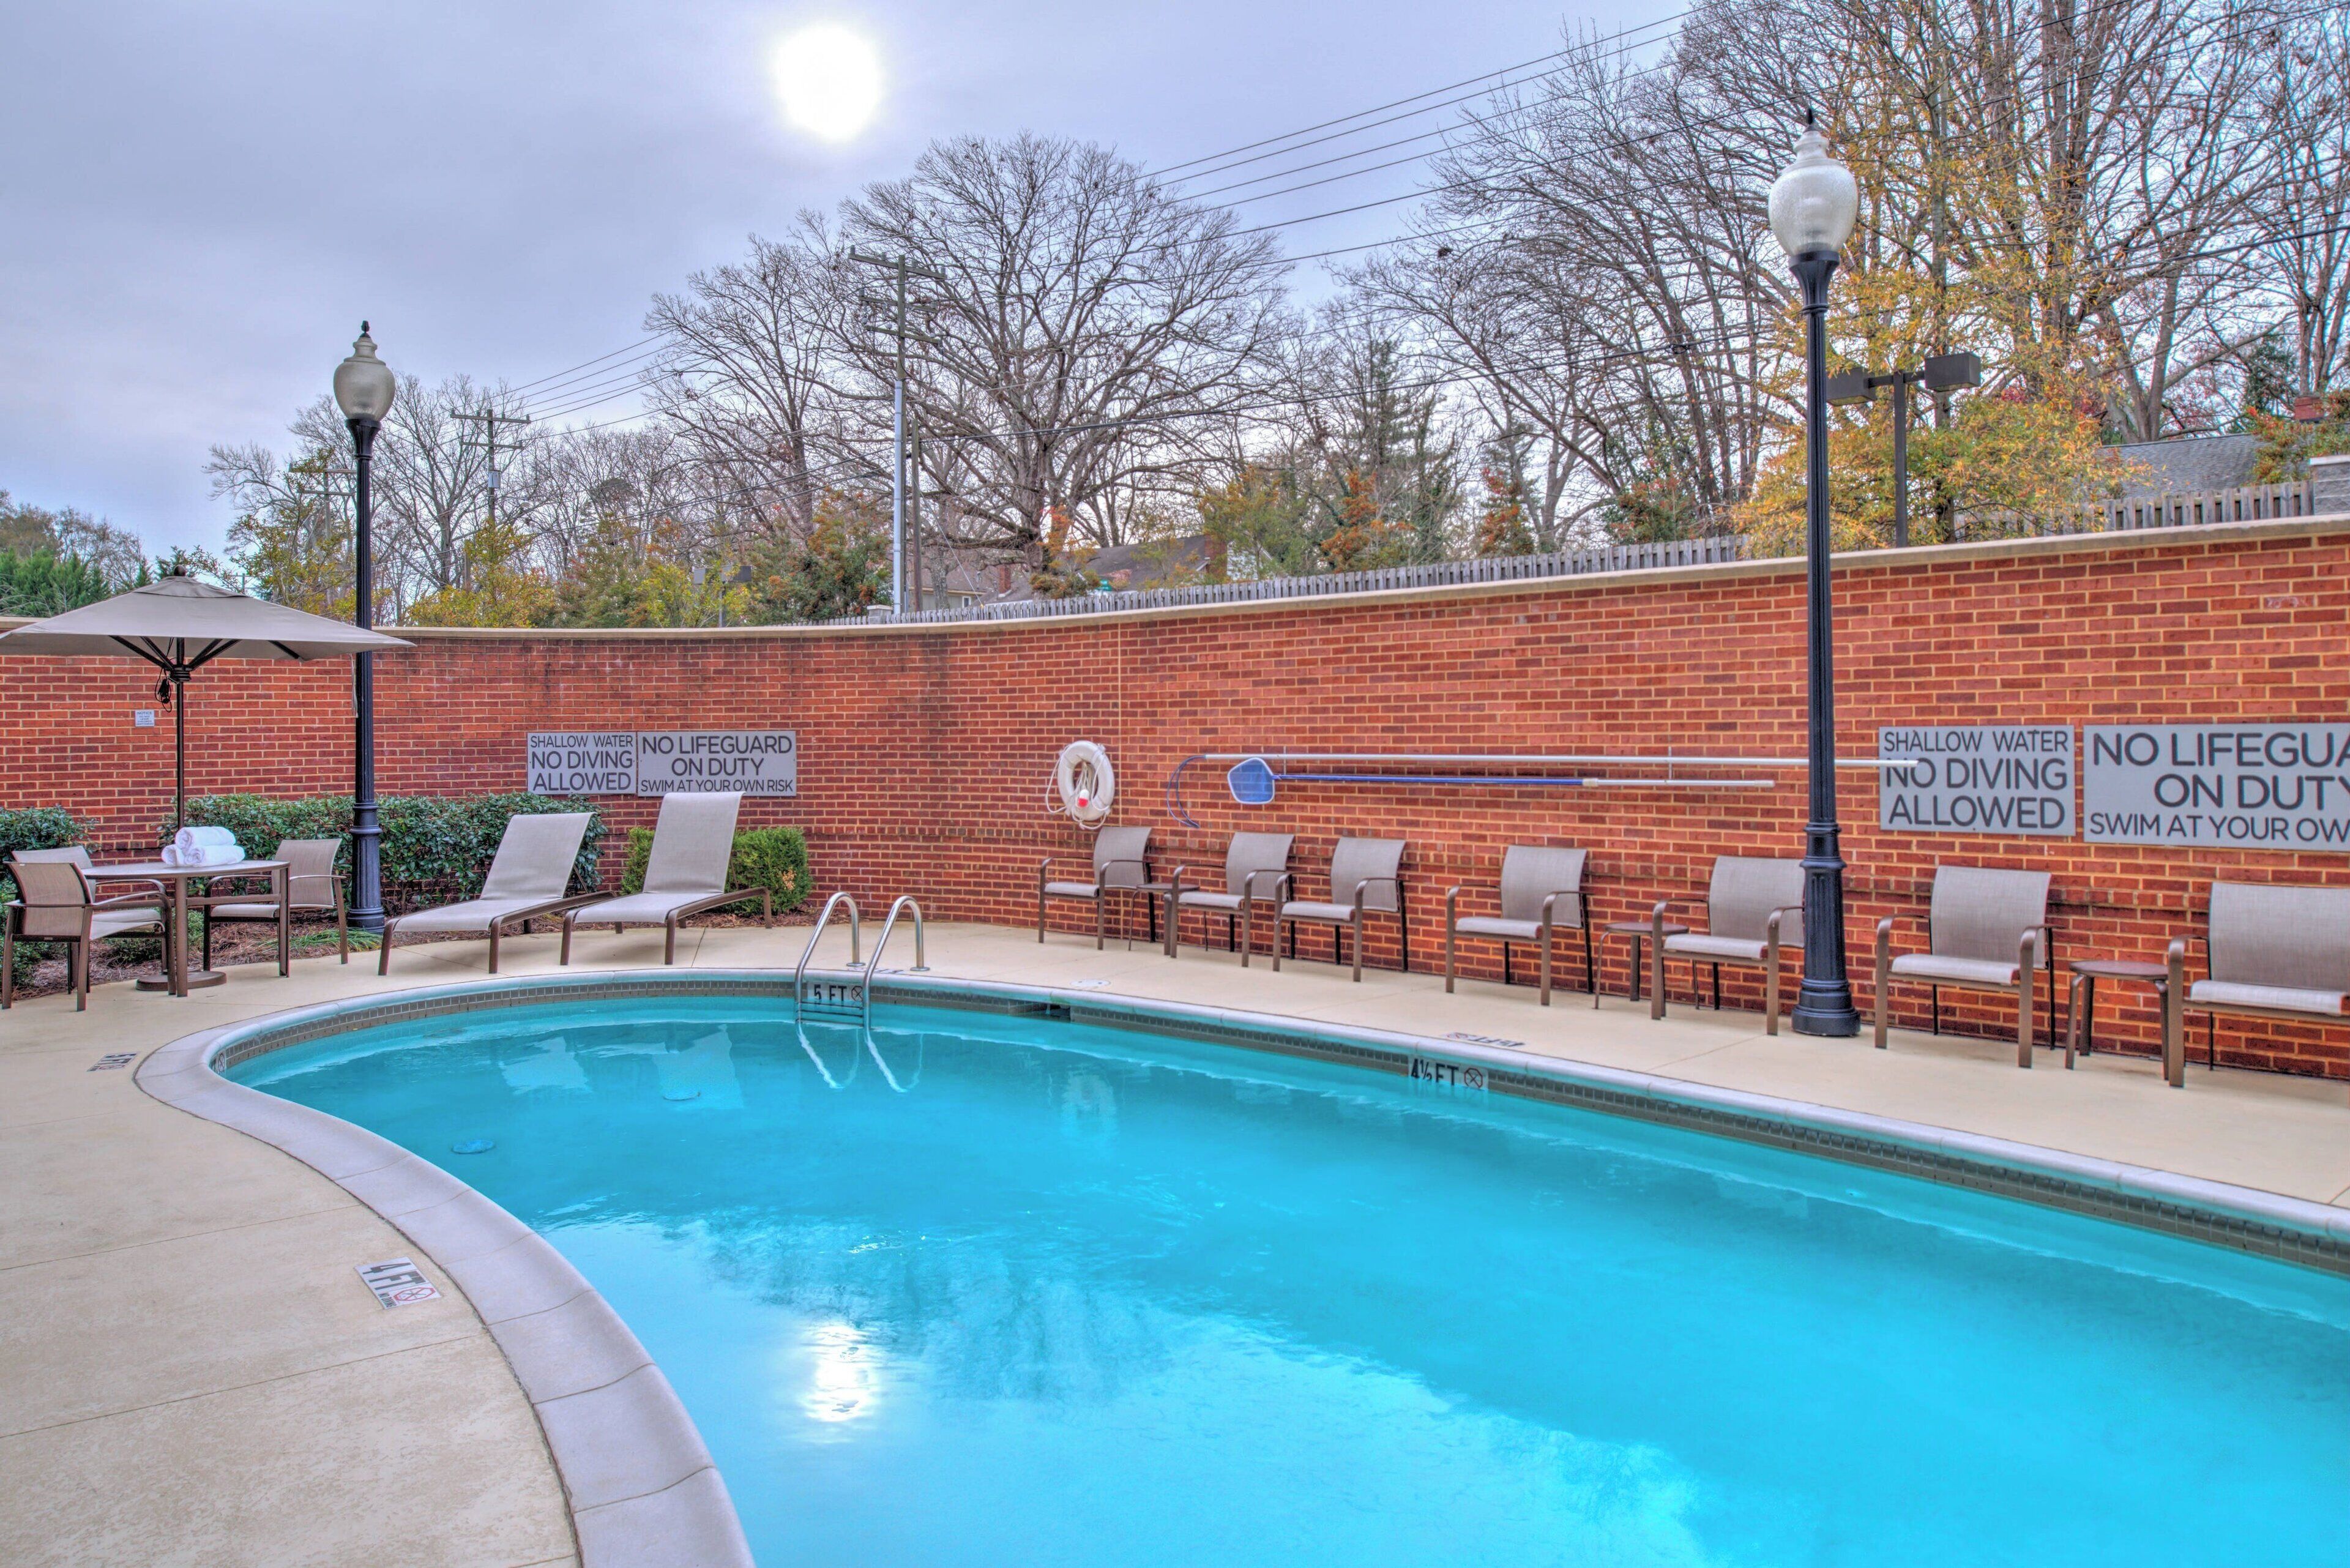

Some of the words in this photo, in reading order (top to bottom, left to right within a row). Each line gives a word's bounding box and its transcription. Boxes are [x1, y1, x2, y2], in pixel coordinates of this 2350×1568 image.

[531, 735, 588, 748] SHALLOW
[594, 735, 633, 747] WATER
[643, 736, 674, 754] NO
[679, 736, 792, 754] LIFEGUARD
[1884, 731, 1983, 752] SHALLOW
[1993, 730, 2068, 752] WATER
[2093, 733, 2160, 766] NO
[532, 750, 562, 769] NO
[567, 750, 633, 769] DIVING
[671, 758, 703, 776] ON
[709, 758, 764, 776] DUTY
[533, 772, 632, 791] ALLOWED
[1886, 758, 1936, 788] NO
[1947, 758, 2067, 790] DIVING
[641, 779, 673, 792] SWIM
[677, 780, 693, 792] AT
[696, 780, 730, 792] YOUR
[733, 779, 764, 792] OWN
[767, 779, 793, 792] RISK
[2154, 774, 2223, 808] ON
[1889, 794, 2065, 829] ALLOWED
[2089, 812, 2160, 837] SWIM
[2167, 815, 2203, 837] AT
[2209, 815, 2289, 841] YOUR
[814, 984, 822, 1001] 5
[829, 985, 847, 1001] FT
[1436, 1063, 1459, 1086] FT
[362, 1263, 411, 1274] 4
[368, 1271, 426, 1290] FT
[381, 1296, 397, 1308] DIVING
